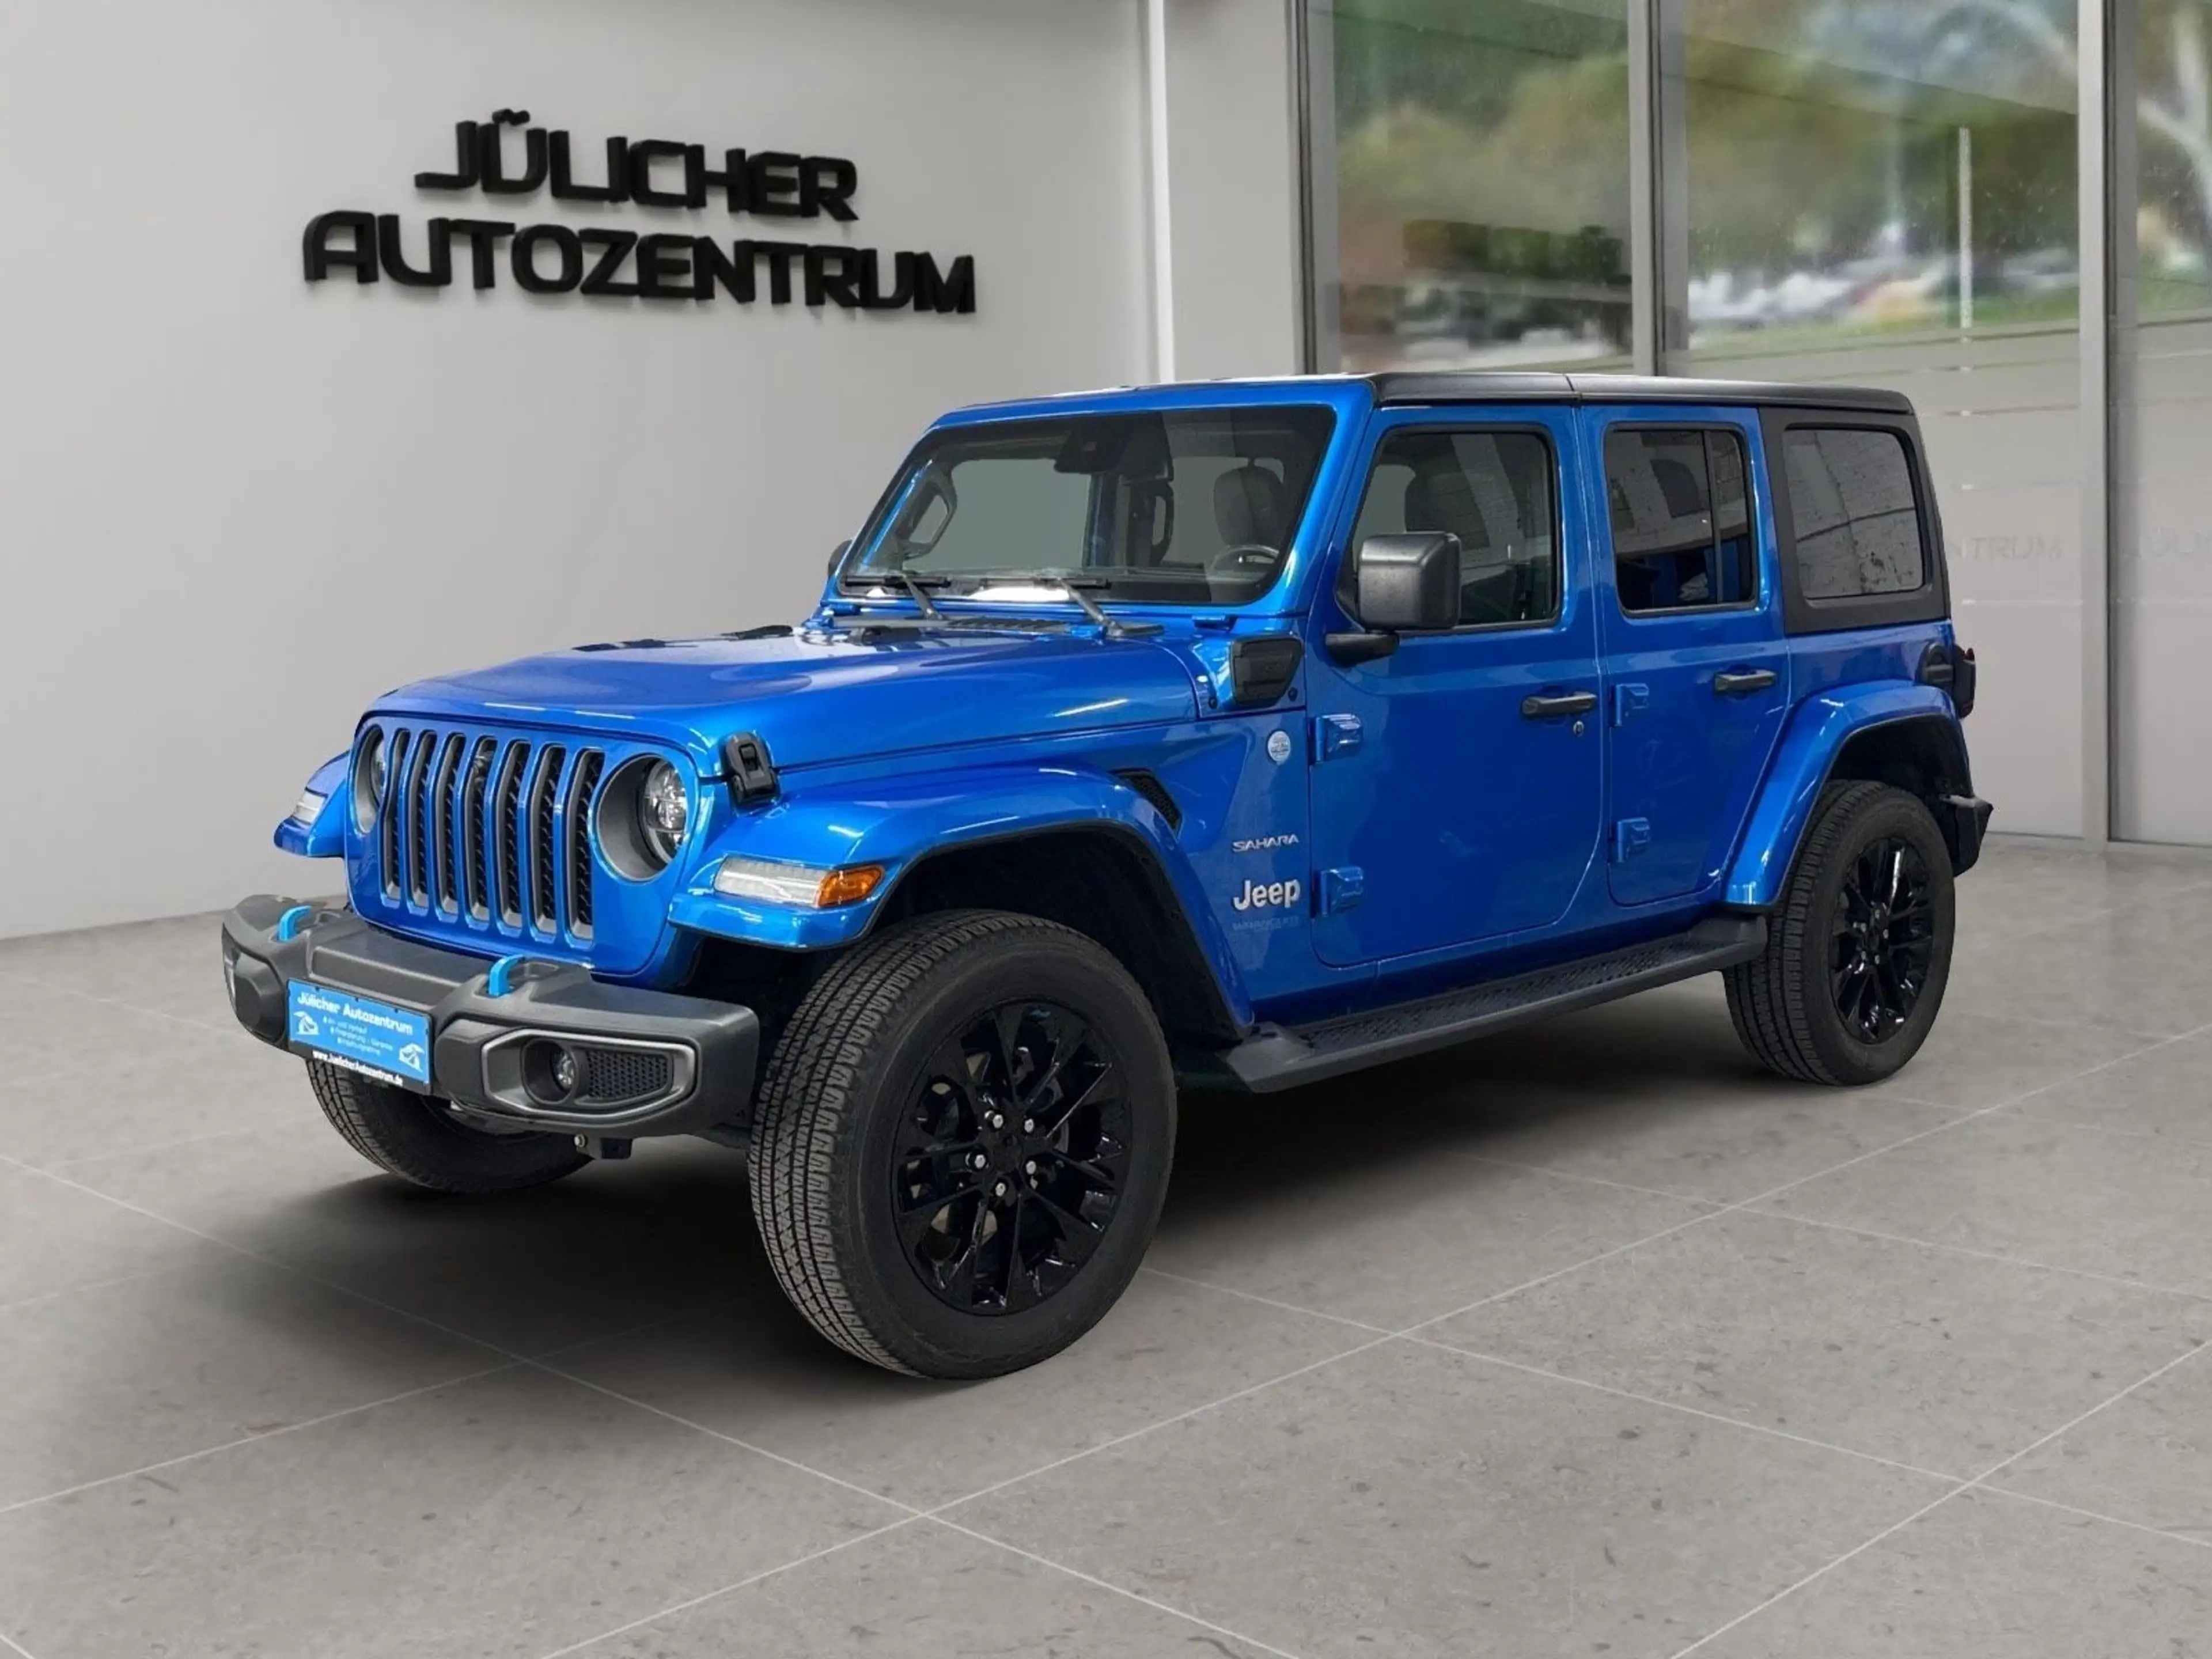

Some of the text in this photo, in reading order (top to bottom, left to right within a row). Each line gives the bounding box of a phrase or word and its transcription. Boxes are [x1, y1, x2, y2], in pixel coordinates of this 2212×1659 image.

[414, 109, 859, 221] JÜLICHER
[302, 210, 976, 313] AUTOZENTRUM
[1232, 834, 1299, 852] SAHARA
[1233, 879, 1301, 910] Jeep
[297, 991, 341, 1014] Jülicher
[343, 1003, 413, 1036] Autozentrum
